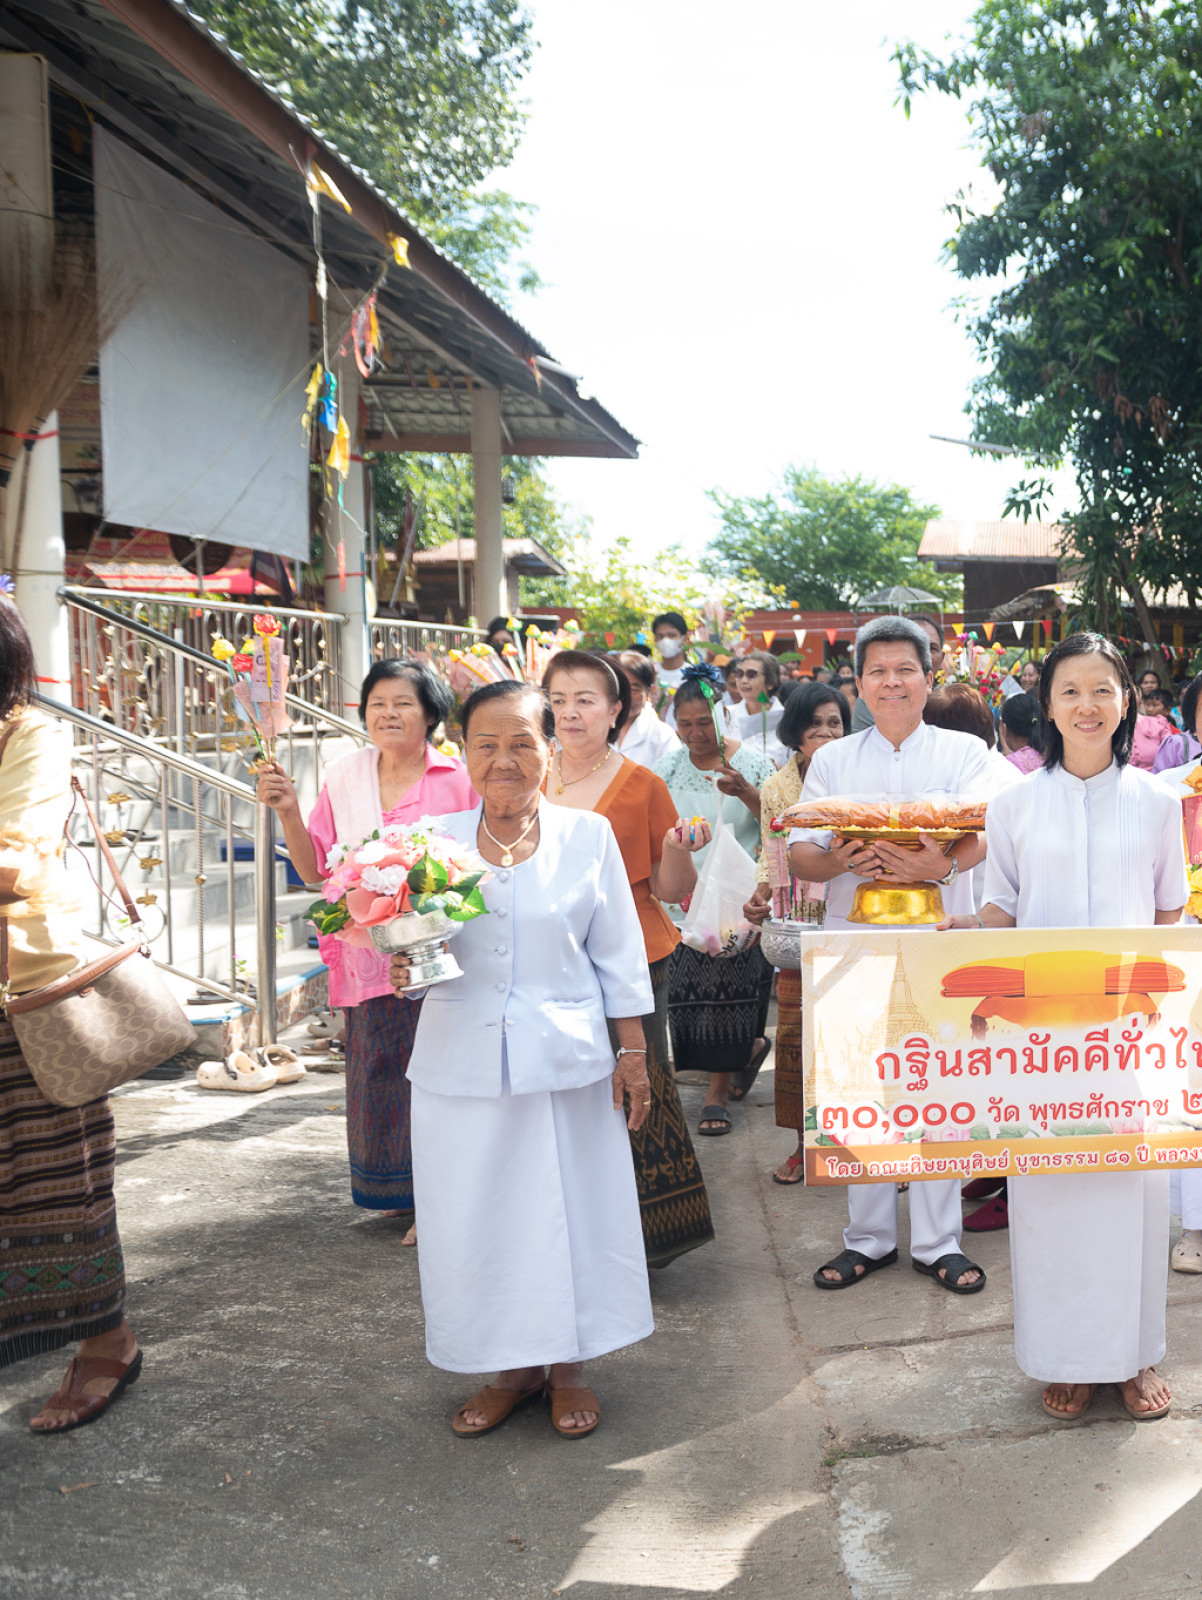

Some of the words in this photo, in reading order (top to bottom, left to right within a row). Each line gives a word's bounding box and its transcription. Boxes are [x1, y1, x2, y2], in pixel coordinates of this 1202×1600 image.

[822, 1101, 976, 1134] ๓๐,๐๐๐
[987, 1096, 1020, 1123] วัด
[1028, 1092, 1169, 1131] พุทธศักราช
[827, 1157, 862, 1176] โดย
[868, 1150, 1009, 1177] คณะศิษยานุศิษย์
[1016, 1148, 1099, 1172] บูชาธรรม
[1105, 1152, 1130, 1164] ๘๑
[1136, 1143, 1149, 1163] ปี
